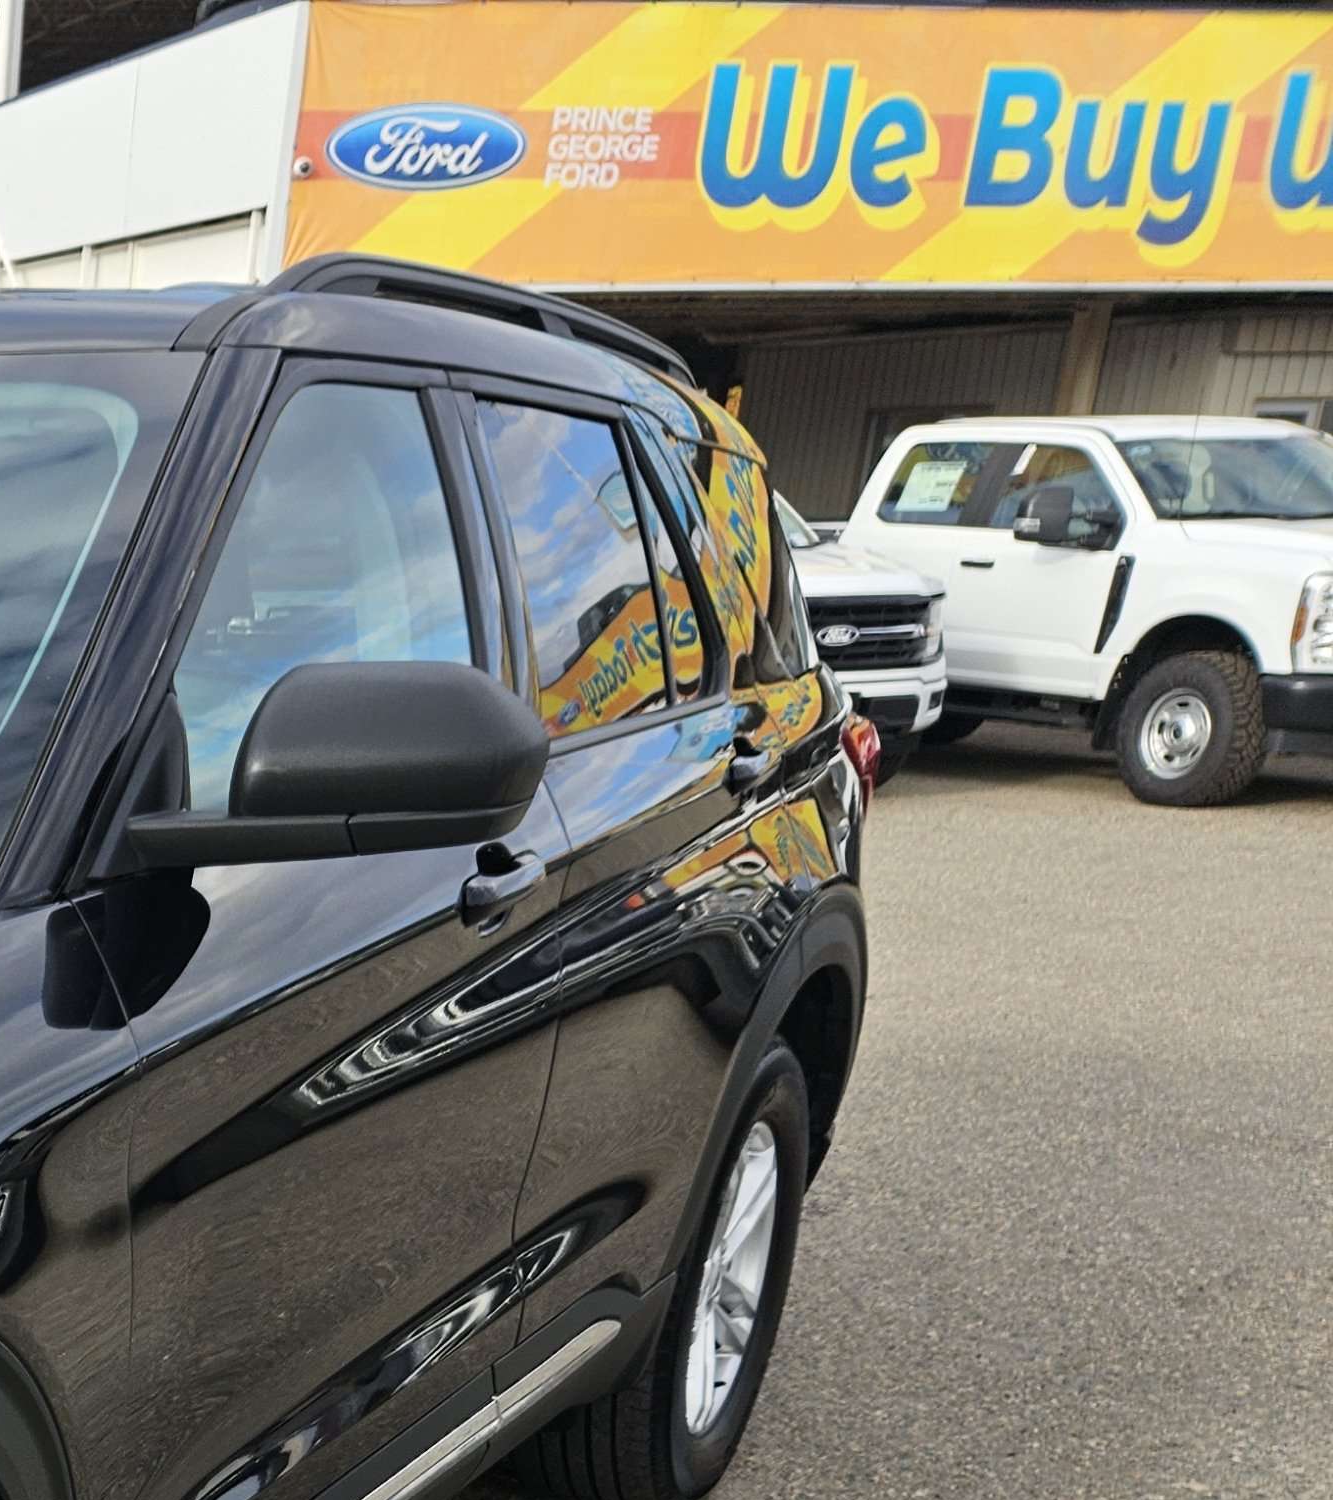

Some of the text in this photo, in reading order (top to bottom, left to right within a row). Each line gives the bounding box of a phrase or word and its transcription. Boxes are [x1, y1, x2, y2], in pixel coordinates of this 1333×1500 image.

[551, 105, 654, 133] PRINCE
[364, 115, 489, 176] Ford
[547, 134, 660, 162] GEORGE
[700, 63, 928, 209] We
[963, 67, 1234, 246] Buy
[543, 162, 621, 190] FORD
